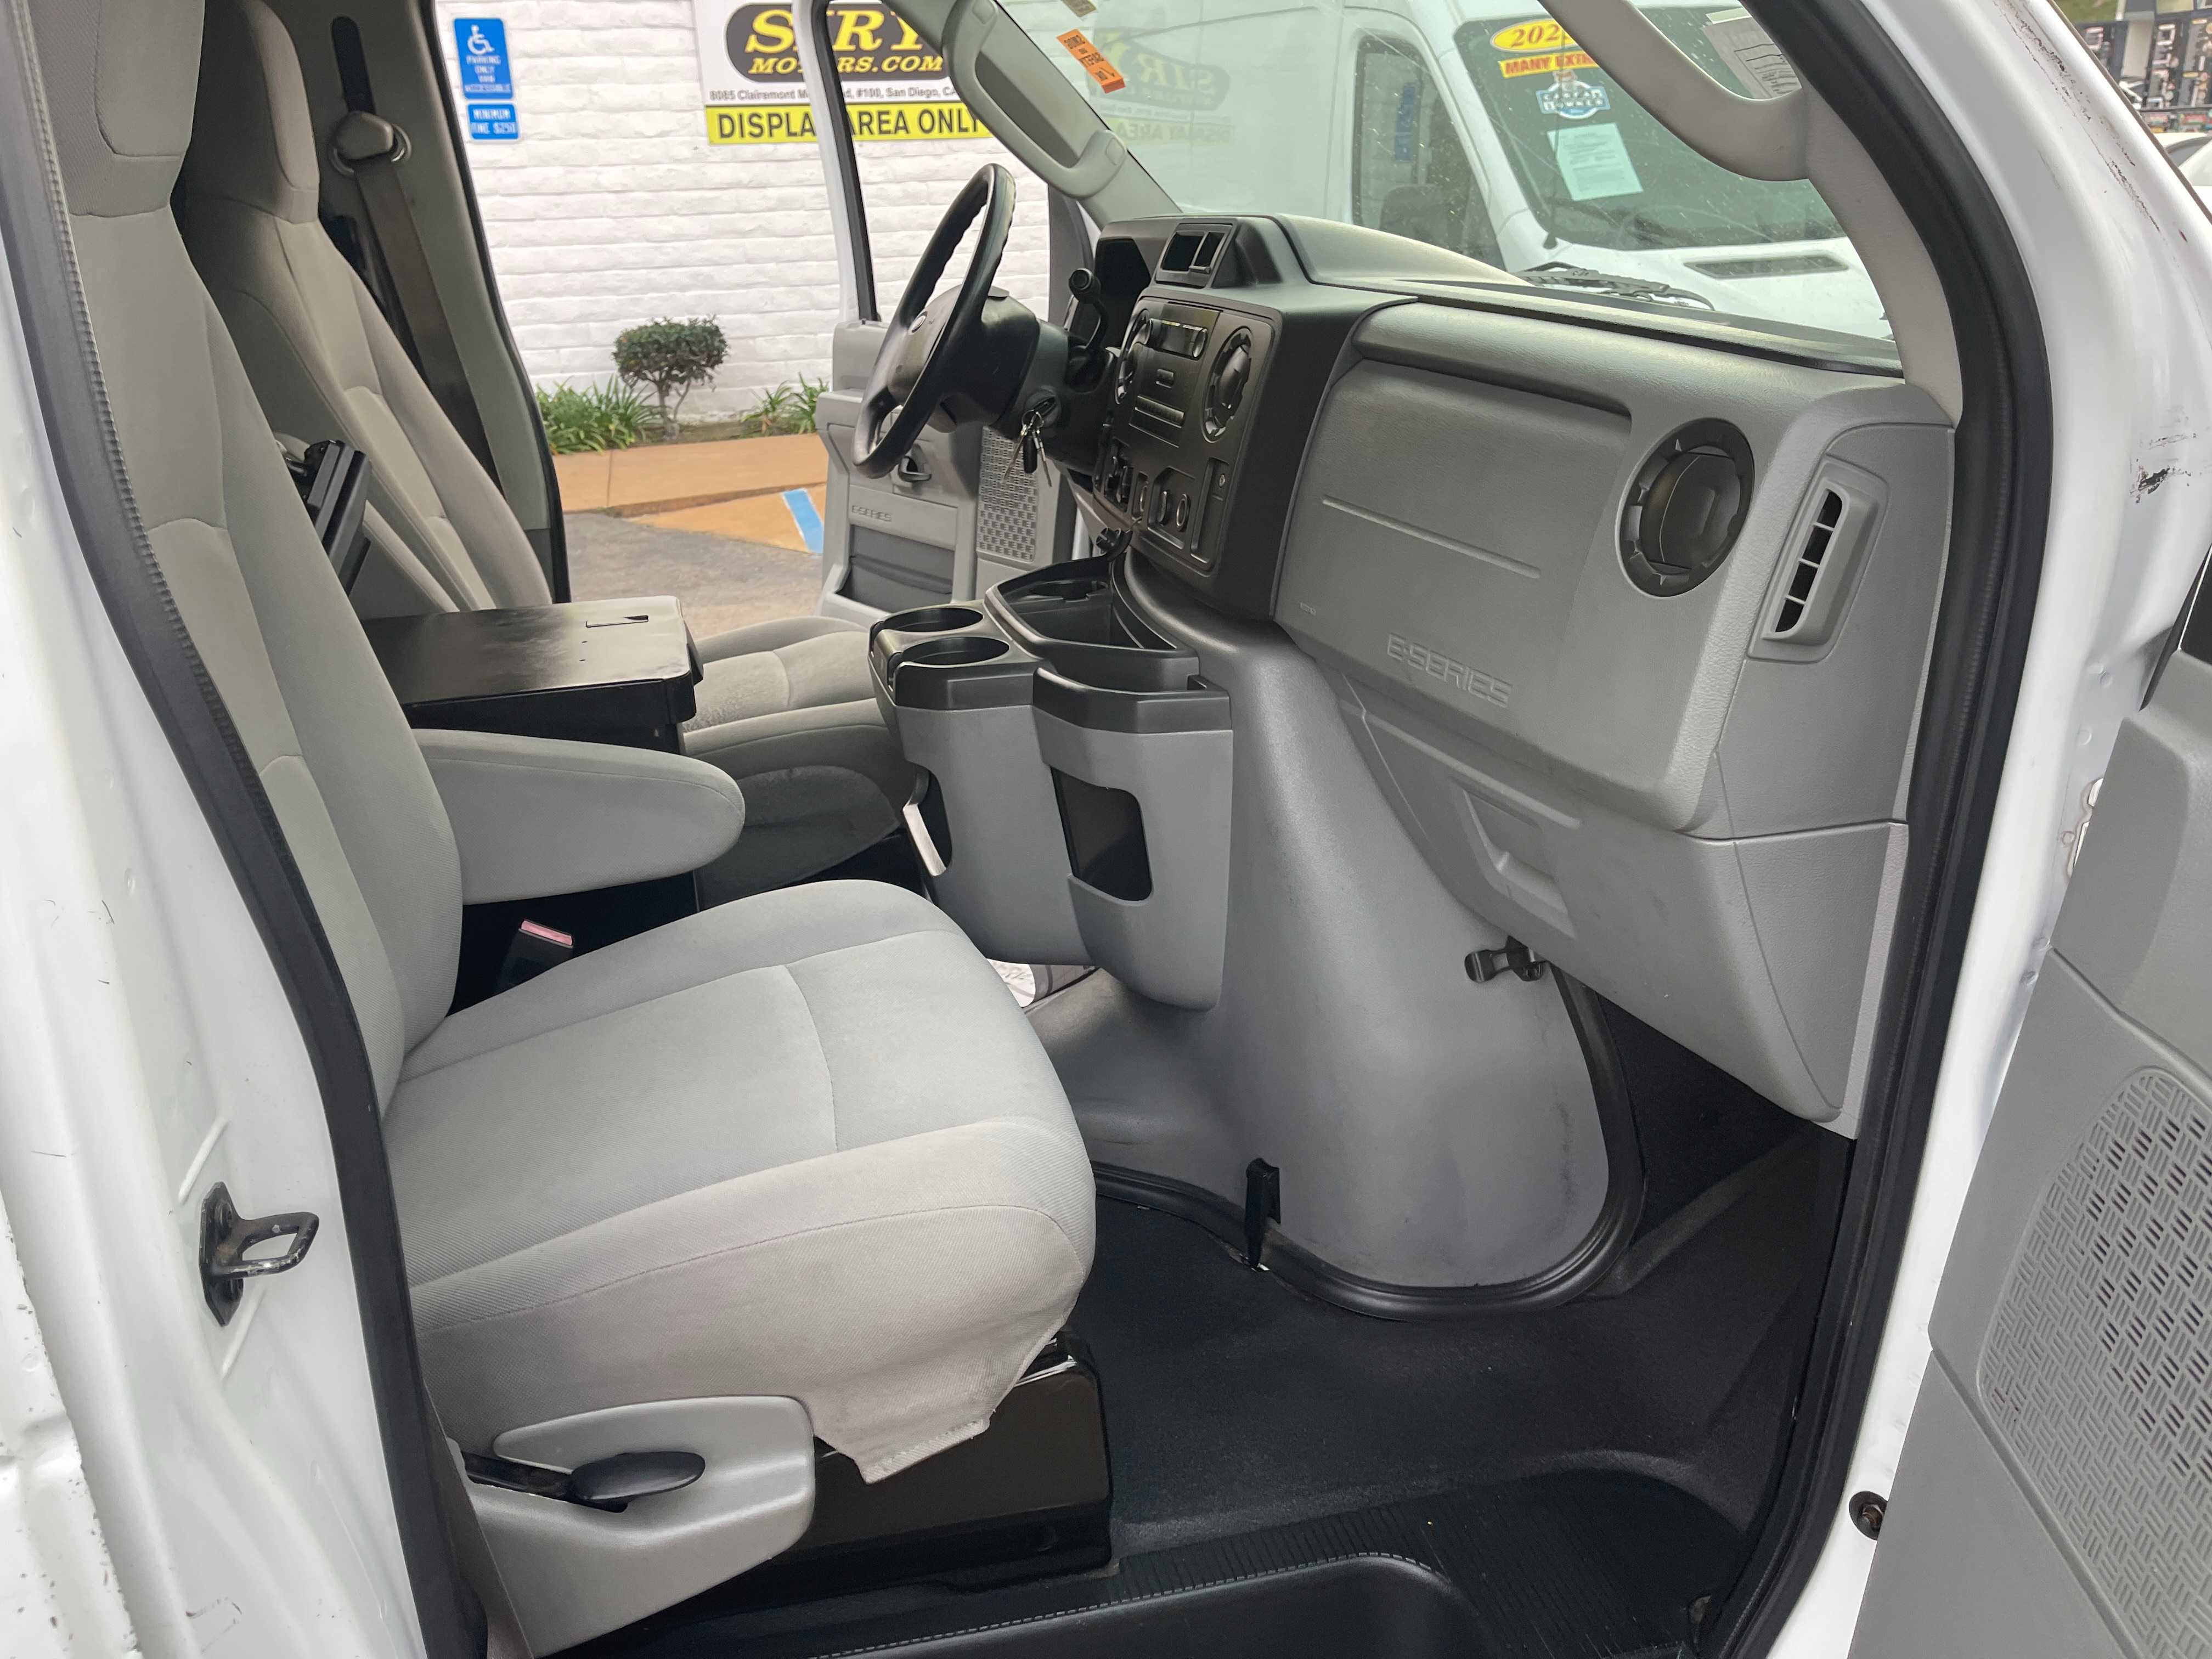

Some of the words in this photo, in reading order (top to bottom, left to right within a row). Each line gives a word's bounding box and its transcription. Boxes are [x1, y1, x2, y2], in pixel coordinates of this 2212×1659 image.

[744, 9, 923, 53] SRY
[1511, 24, 1568, 48] 202
[748, 55, 943, 74] MORS.COM
[1505, 57, 1550, 75] MANY
[737, 89, 795, 100] Clairemont
[885, 87, 906, 98] San
[908, 86, 941, 99] Diego,
[718, 111, 817, 138] DISPLA
